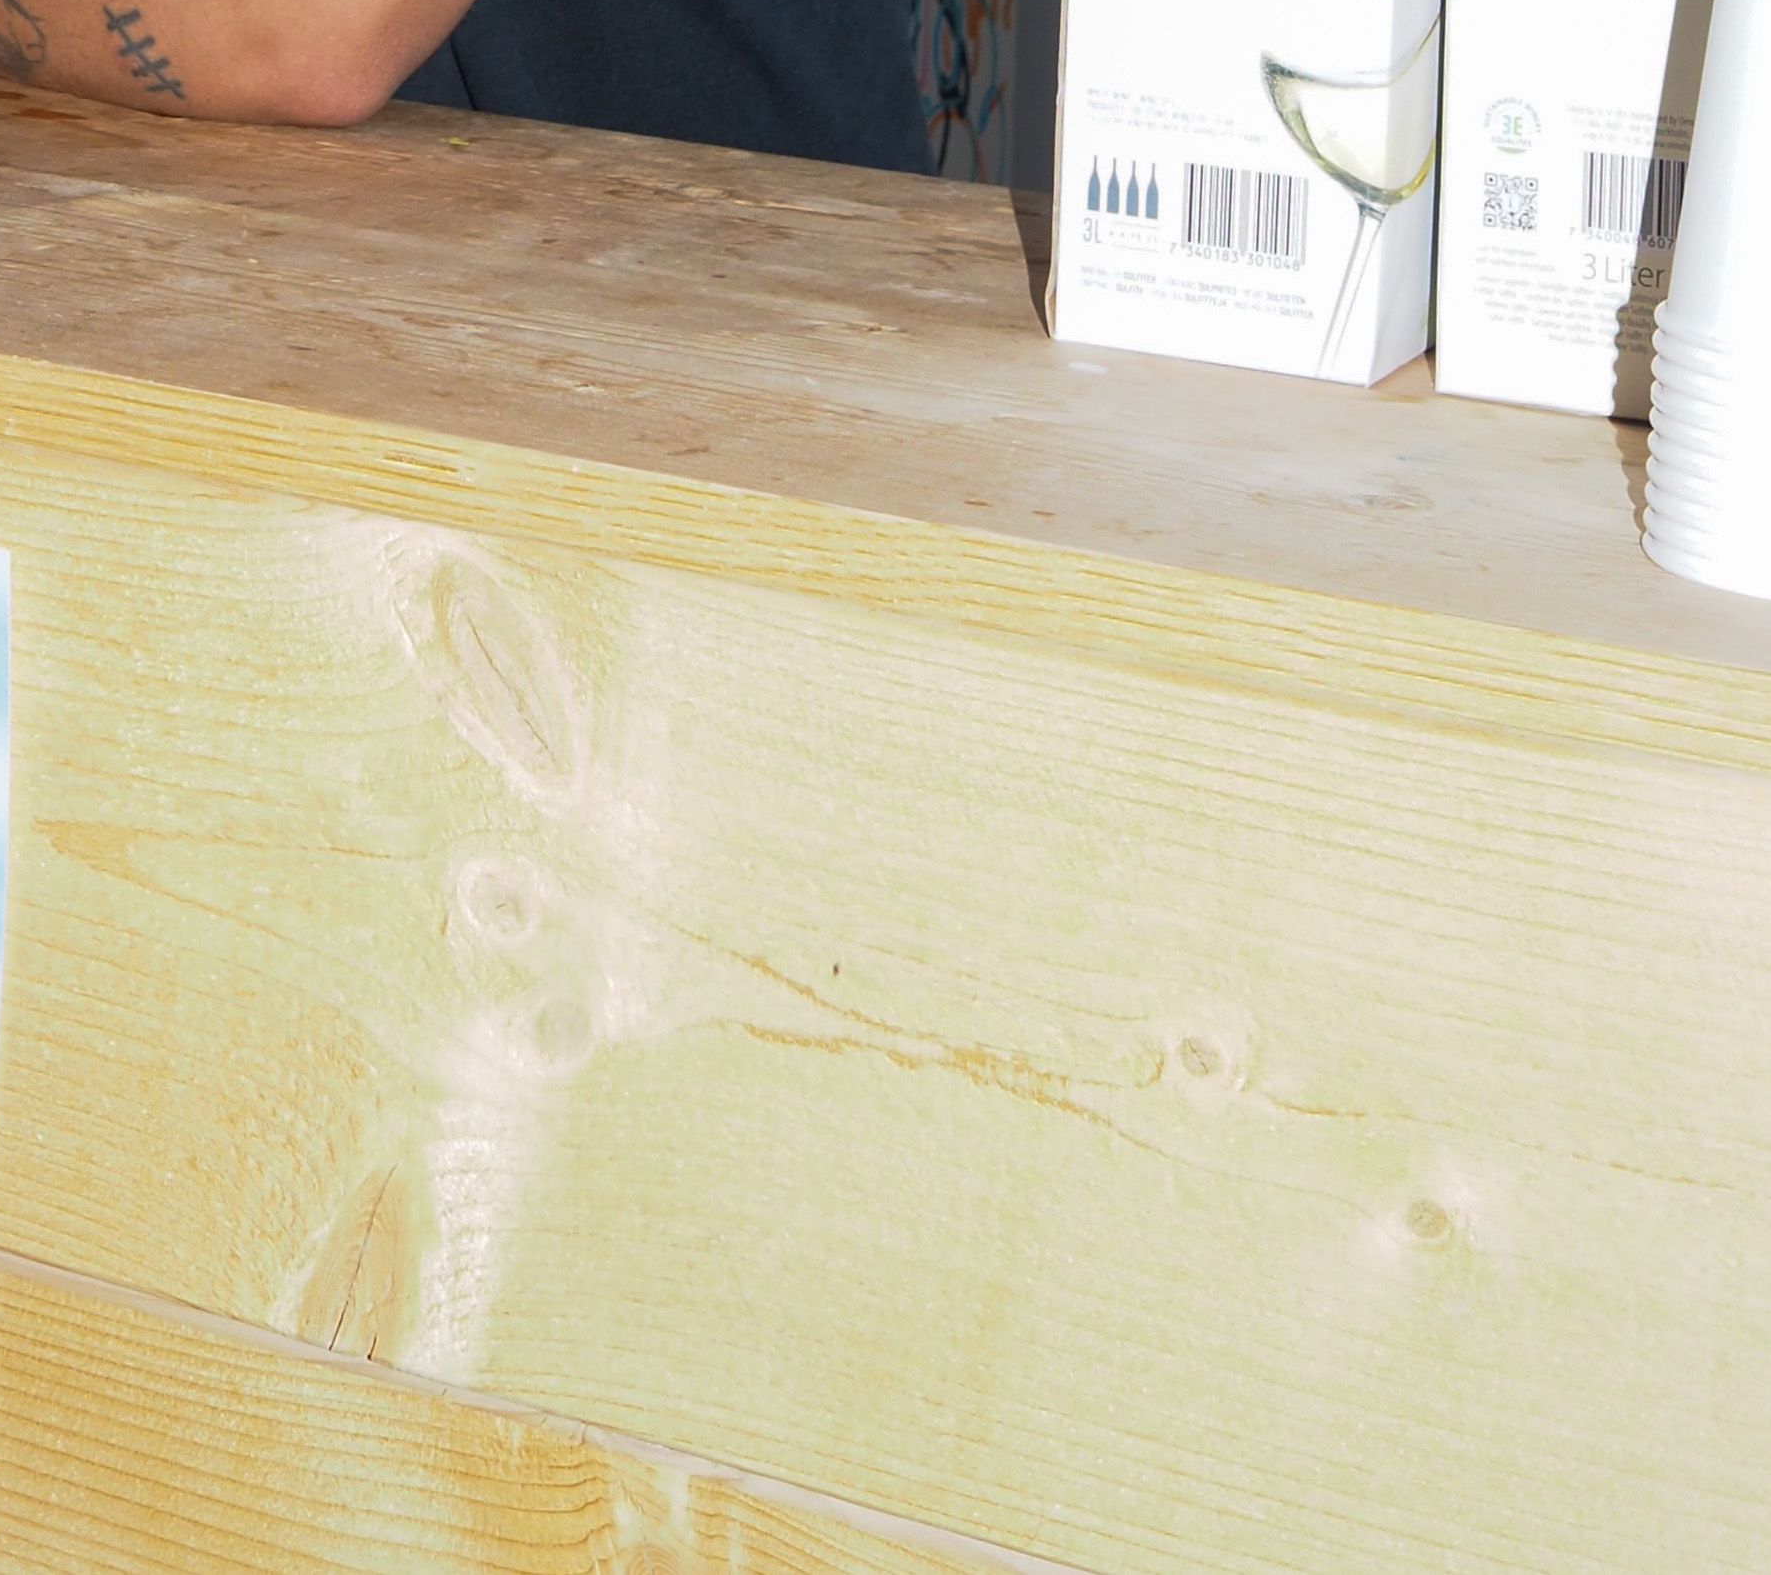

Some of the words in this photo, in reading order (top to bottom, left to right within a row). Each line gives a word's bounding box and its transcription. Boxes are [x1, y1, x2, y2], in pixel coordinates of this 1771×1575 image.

[1083, 217, 1102, 244] 3L
[1169, 242, 1178, 254] 7
[1185, 245, 1239, 263] 340183
[1247, 255, 1301, 272] 301048
[1582, 253, 1597, 280] 3
[1604, 257, 1665, 289] Liter
